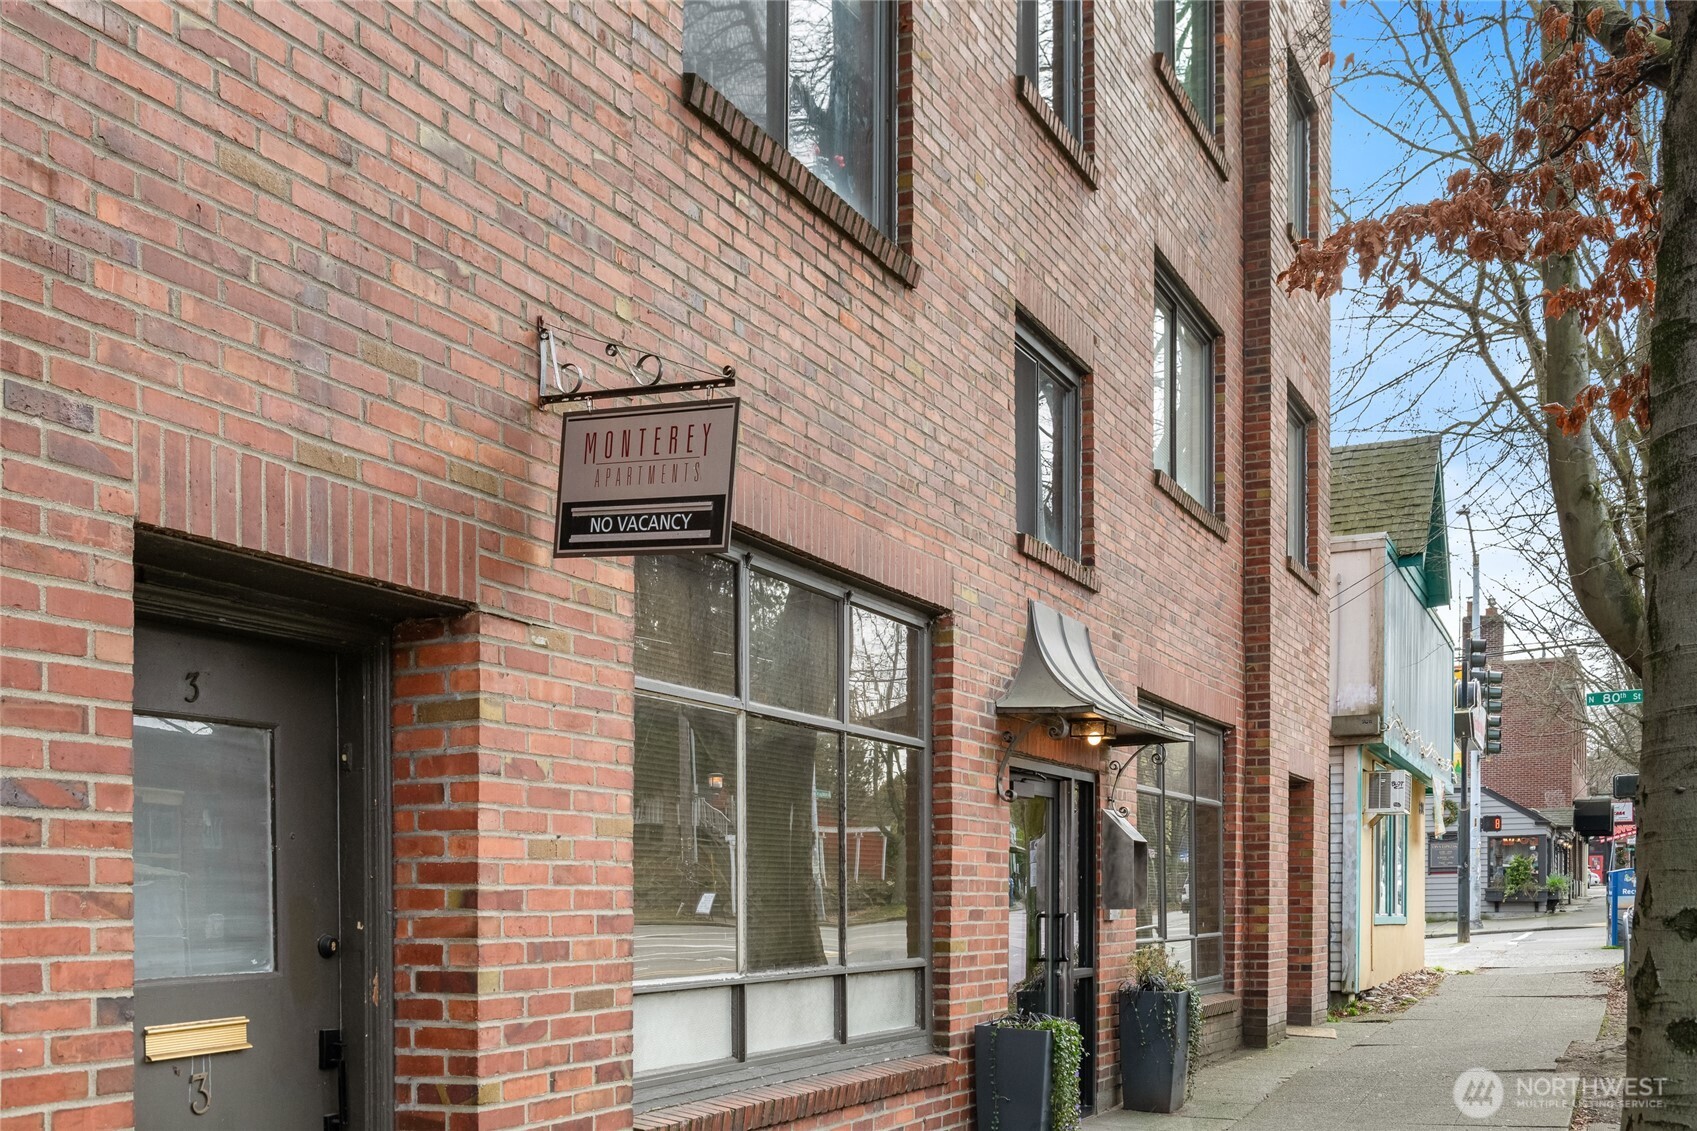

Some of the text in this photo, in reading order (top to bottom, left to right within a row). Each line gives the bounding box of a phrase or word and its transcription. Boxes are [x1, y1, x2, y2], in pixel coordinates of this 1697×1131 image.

[583, 422, 712, 465] MONTEREY
[594, 461, 701, 488] APARTMENTS
[590, 513, 693, 533] NO VACANCY
[184, 671, 200, 704] 3
[1602, 692, 1627, 704] 80th
[1632, 692, 1642, 701] St
[189, 1071, 211, 1116] 3
